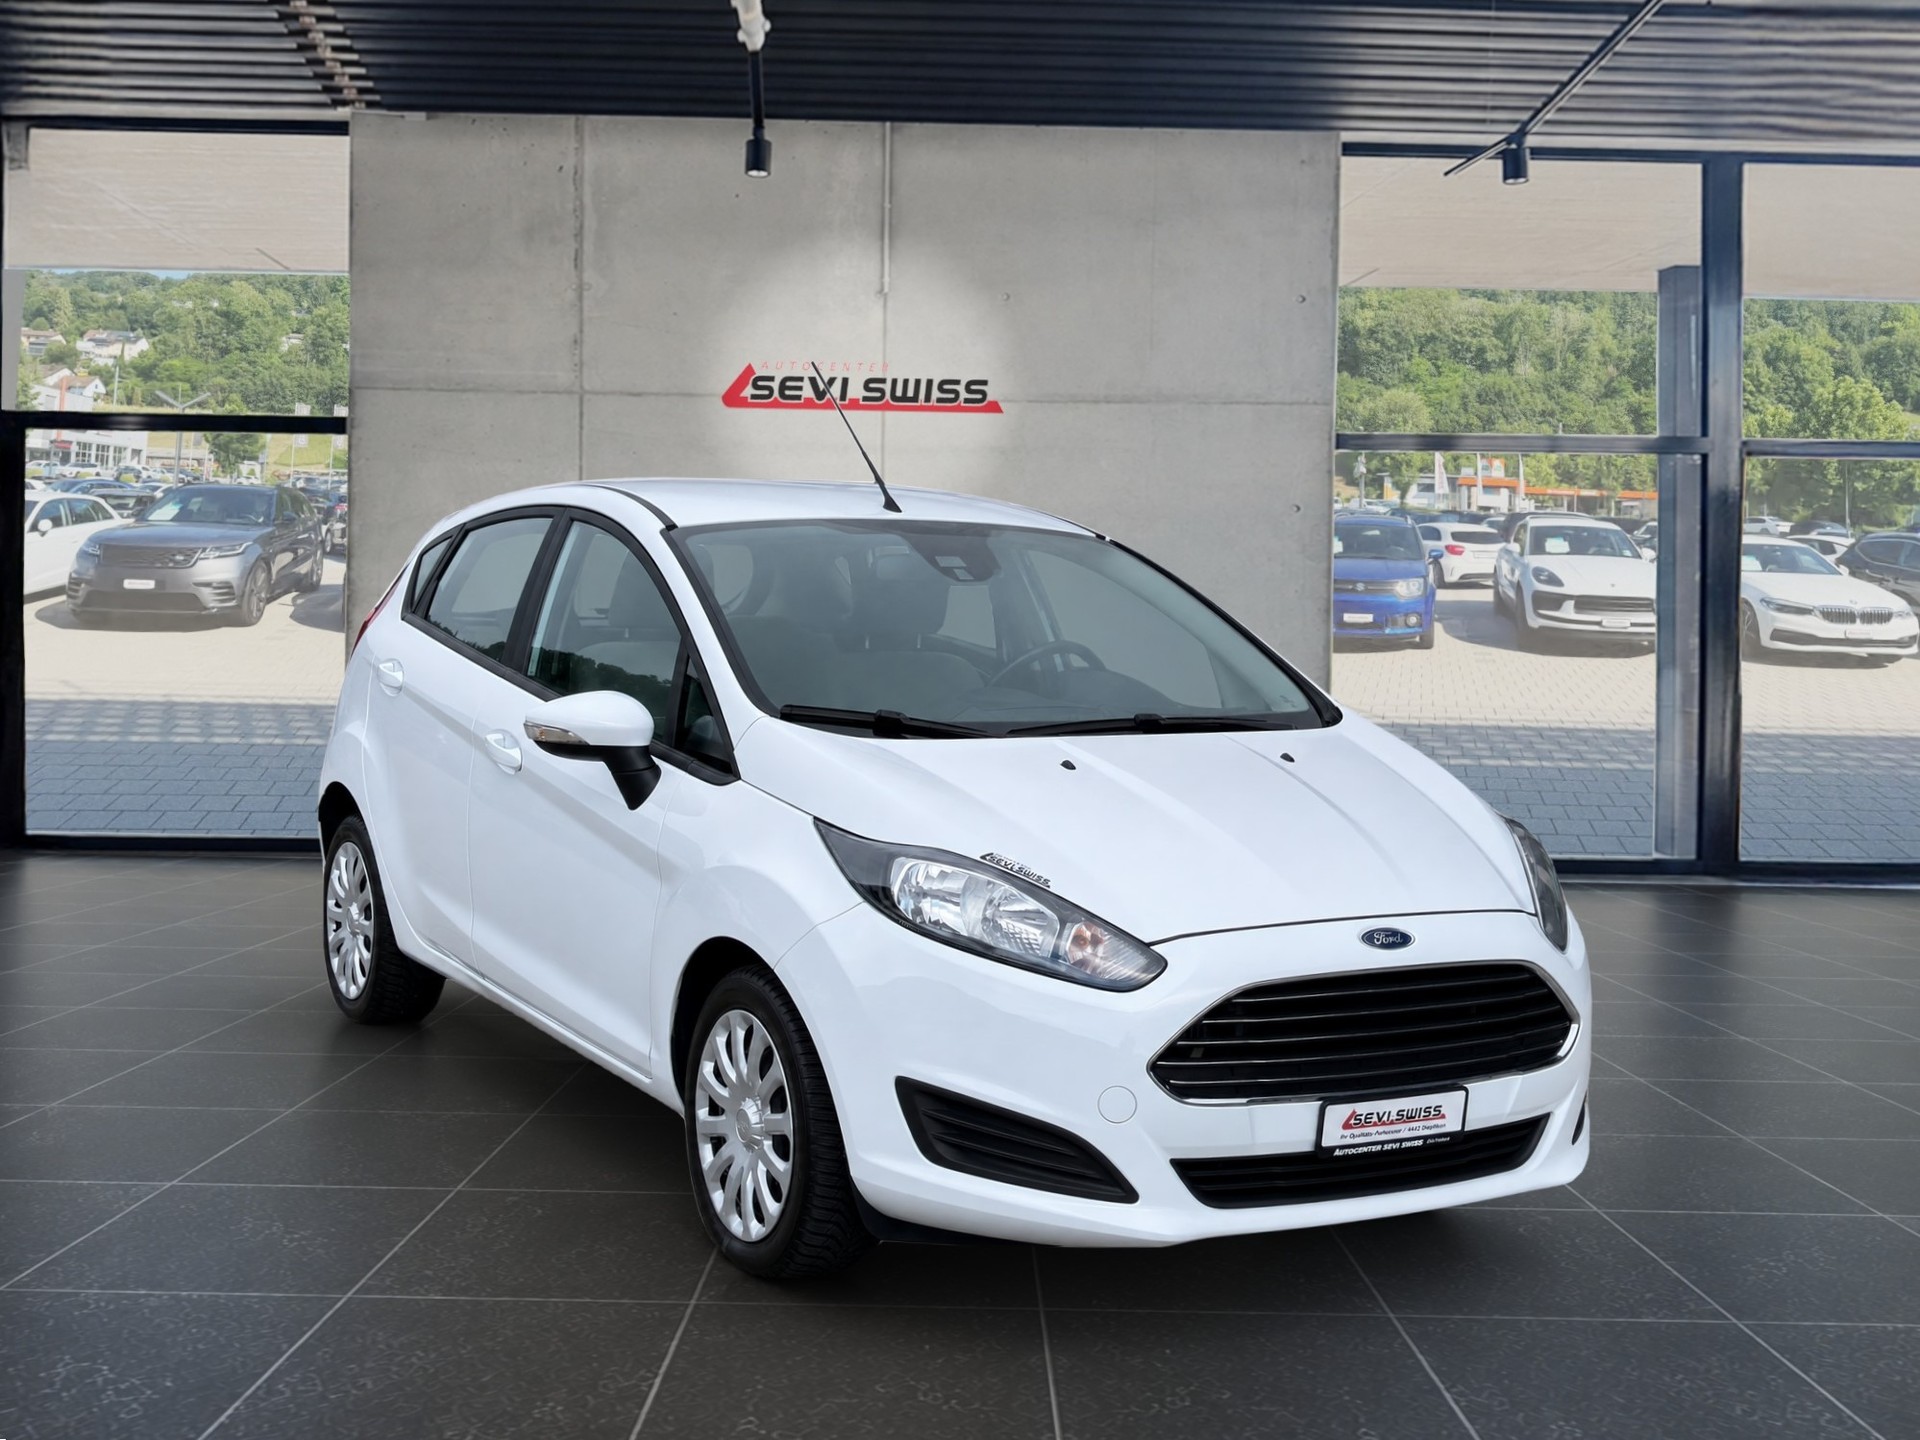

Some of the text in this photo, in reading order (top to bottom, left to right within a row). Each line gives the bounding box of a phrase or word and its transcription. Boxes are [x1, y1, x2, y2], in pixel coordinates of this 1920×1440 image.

[761, 361, 889, 374] AUTOCENTER
[749, 375, 989, 405] SEVI SWISS
[1015, 866, 1051, 885] SWISS
[1373, 931, 1403, 945] Ford
[1352, 1104, 1443, 1126] SEVI SWISS
[1333, 1144, 1382, 1156] AUTOCENTER
[1382, 1142, 1400, 1151] SEVI
[1401, 1139, 1424, 1149] SWISS
